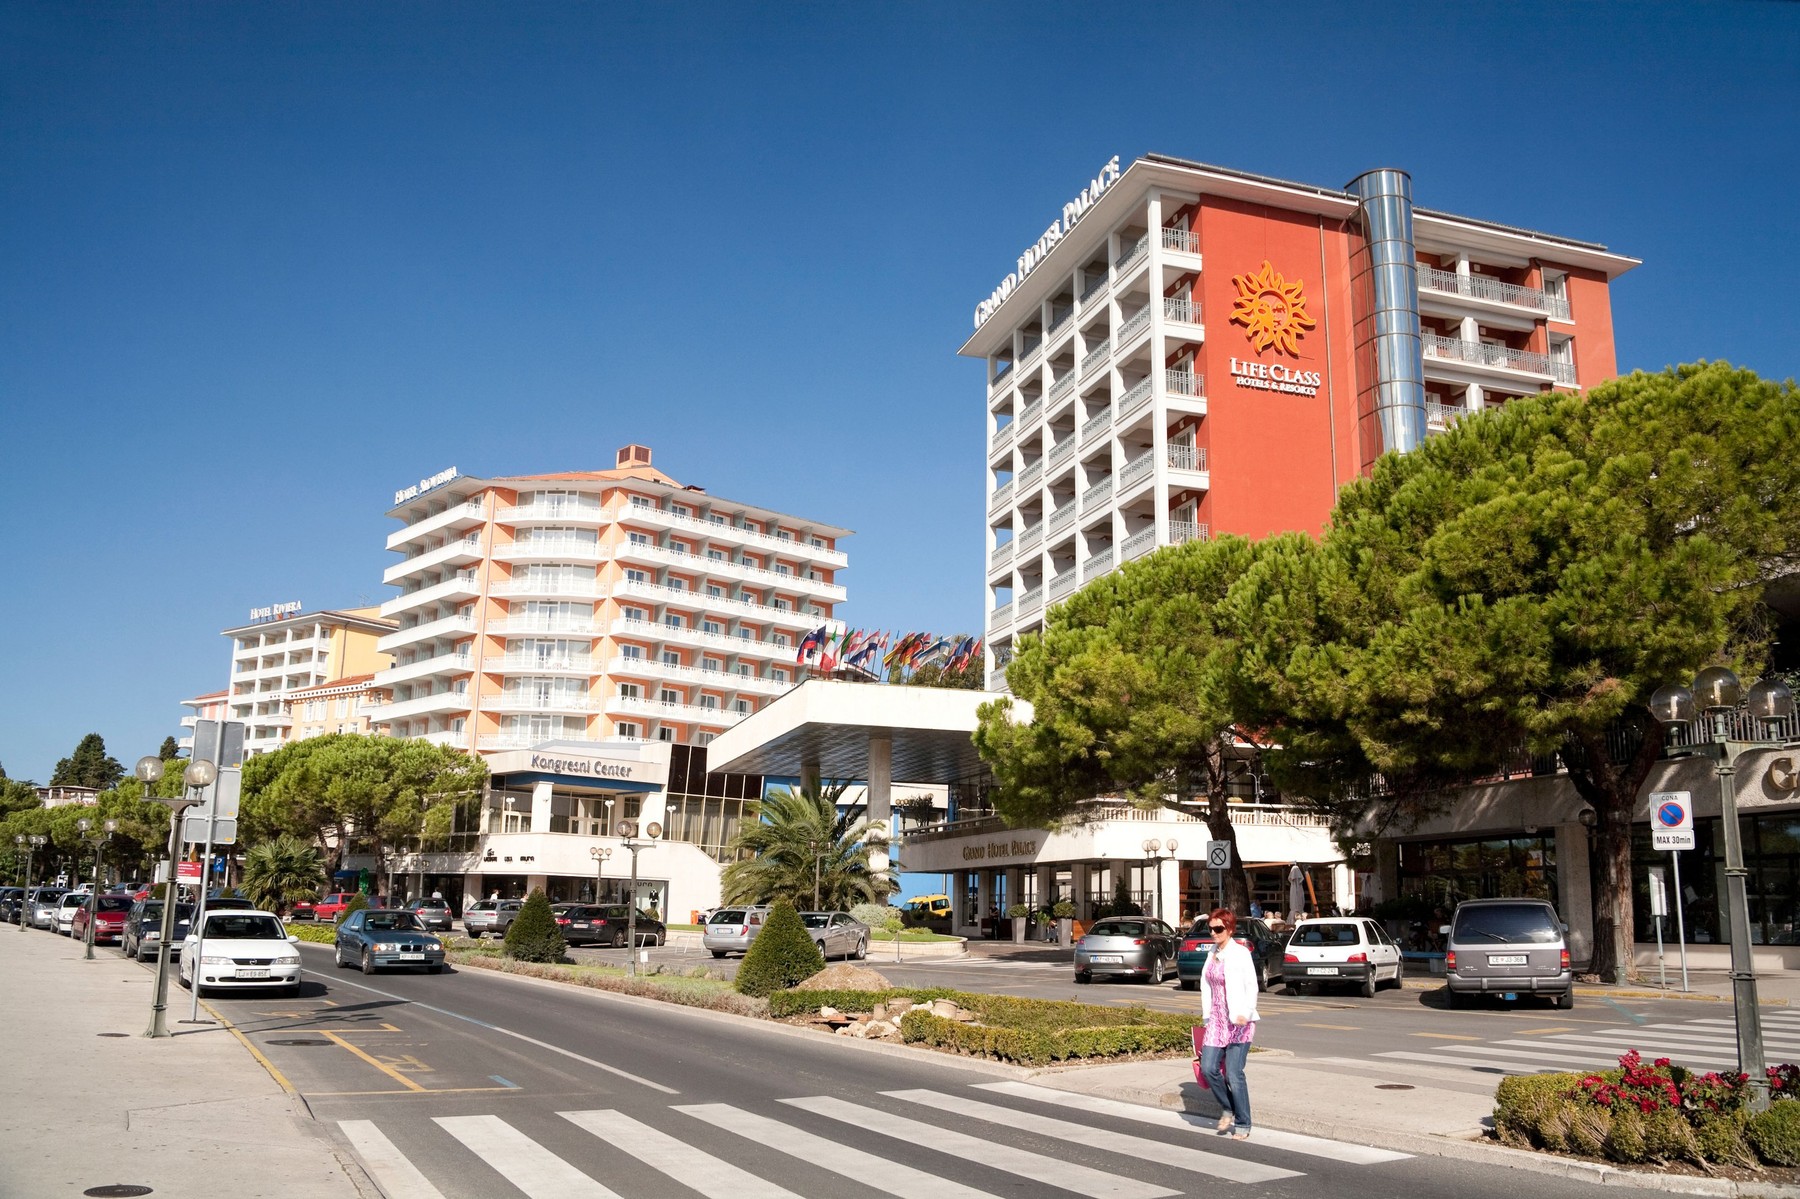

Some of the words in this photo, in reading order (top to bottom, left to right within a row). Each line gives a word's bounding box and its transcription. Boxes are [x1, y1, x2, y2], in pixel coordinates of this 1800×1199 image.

[974, 273, 1017, 330] GRAND
[1017, 219, 1063, 284] HOTEL
[1063, 155, 1120, 232] PALACE
[1236, 376, 1270, 389] HOTELS
[1271, 382, 1279, 390] &
[1279, 383, 1316, 396] RESORTS
[250, 607, 271, 620] HOTEL
[273, 600, 302, 615] RIVIERA
[531, 753, 591, 774] Kongresni
[594, 761, 632, 778] Center
[1656, 836, 1671, 844] MAX
[1672, 836, 1691, 844] 30min
[963, 846, 985, 861] GRAND
[987, 842, 1010, 859] HOTEL
[1011, 840, 1036, 856] PALACE
